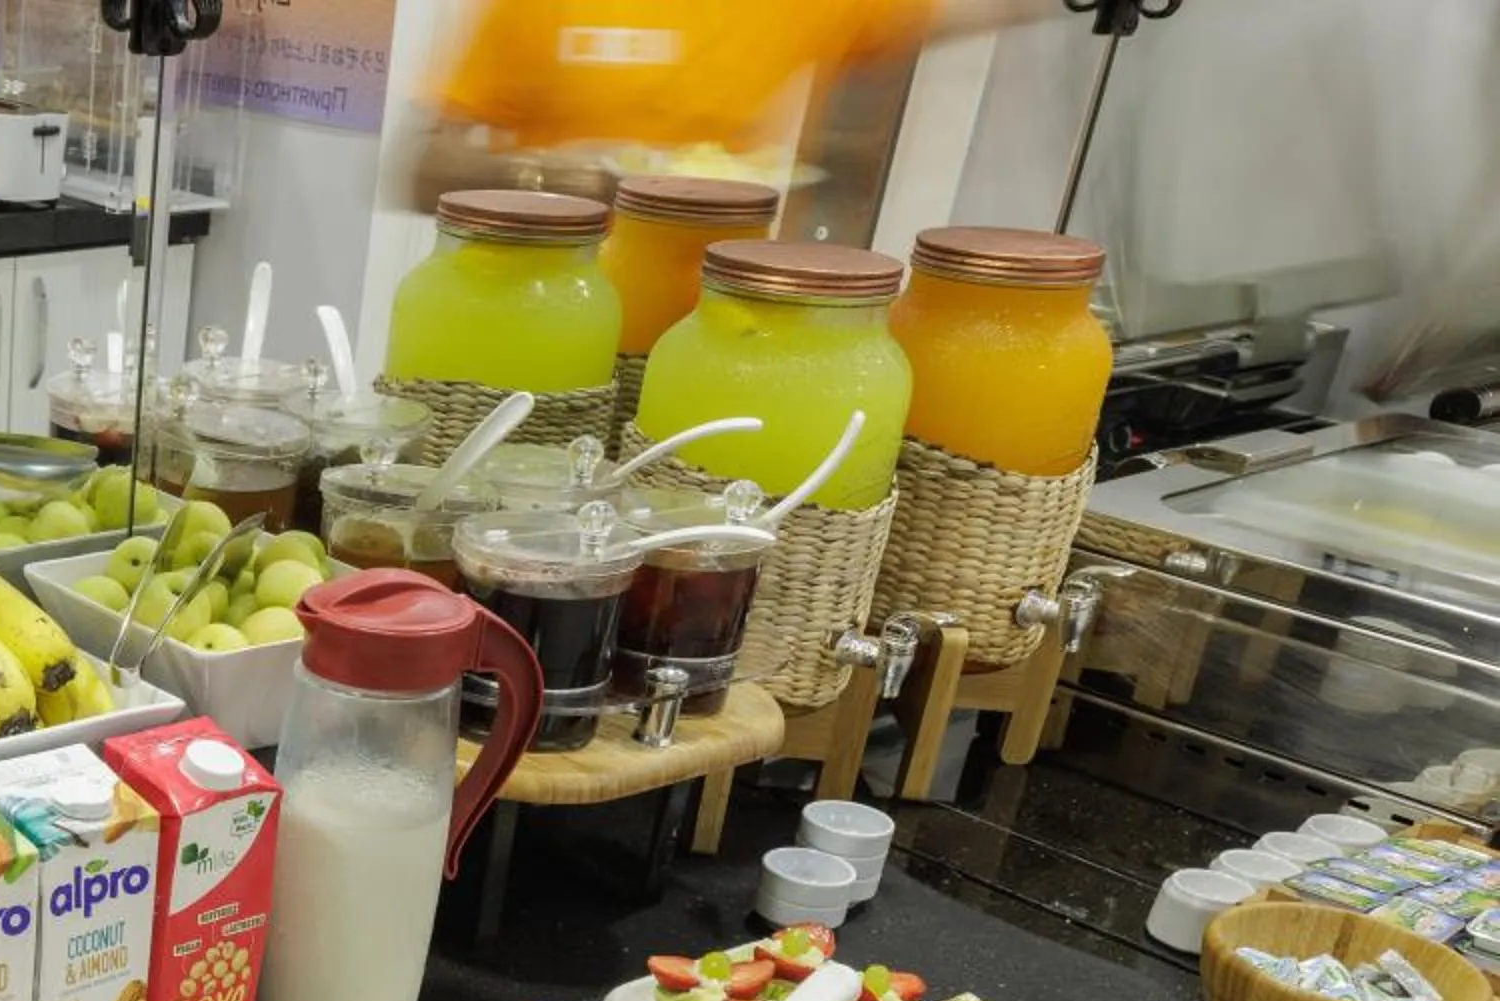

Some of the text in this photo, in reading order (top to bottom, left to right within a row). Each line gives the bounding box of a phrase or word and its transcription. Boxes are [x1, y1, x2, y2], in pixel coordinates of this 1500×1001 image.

[50, 865, 150, 918] alpro
[67, 921, 125, 960] COCONUT
[65, 963, 77, 986] &
[79, 945, 129, 981] ALMOND
